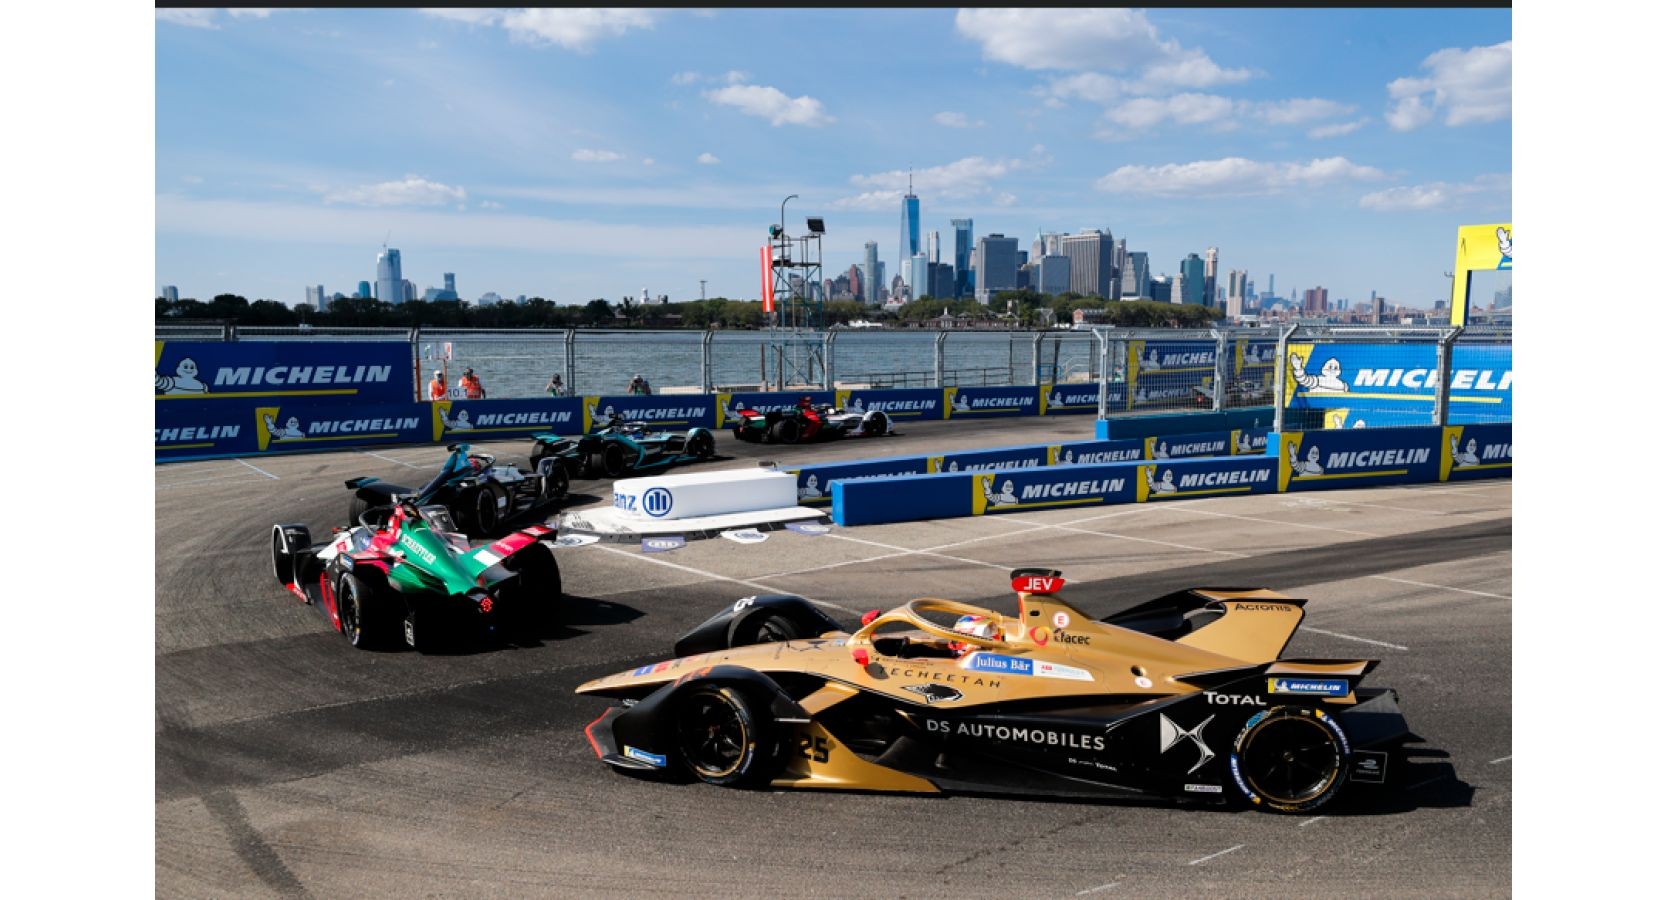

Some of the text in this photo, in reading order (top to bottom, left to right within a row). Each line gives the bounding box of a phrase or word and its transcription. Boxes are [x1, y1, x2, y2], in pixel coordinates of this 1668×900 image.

[1162, 352, 1216, 365] MICHEL
[214, 365, 391, 386] MICHELIN
[868, 399, 936, 411] MICHELIN
[972, 396, 1033, 407] MICHELIN
[1066, 393, 1121, 404] MICHIN
[477, 411, 571, 426] MICHELIN
[623, 407, 706, 419] MICHELIN
[309, 417, 419, 433] MICHELIN
[1171, 441, 1225, 455] MICHELIN
[1078, 449, 1140, 464] MICHELIN
[1327, 448, 1430, 469] MICHELIN
[1180, 469, 1270, 487] MICHELIN
[1022, 479, 1125, 499] MICHELIN
[1024, 578, 1054, 591] JEV
[1235, 603, 1292, 612] Acronis
[976, 656, 1031, 671] Julius Bär
[879, 665, 1001, 688] TECHEETAH
[1290, 683, 1342, 692] MICHELIN
[926, 718, 1106, 751] DS AUTOMOBILES
[800, 734, 829, 764] 25
